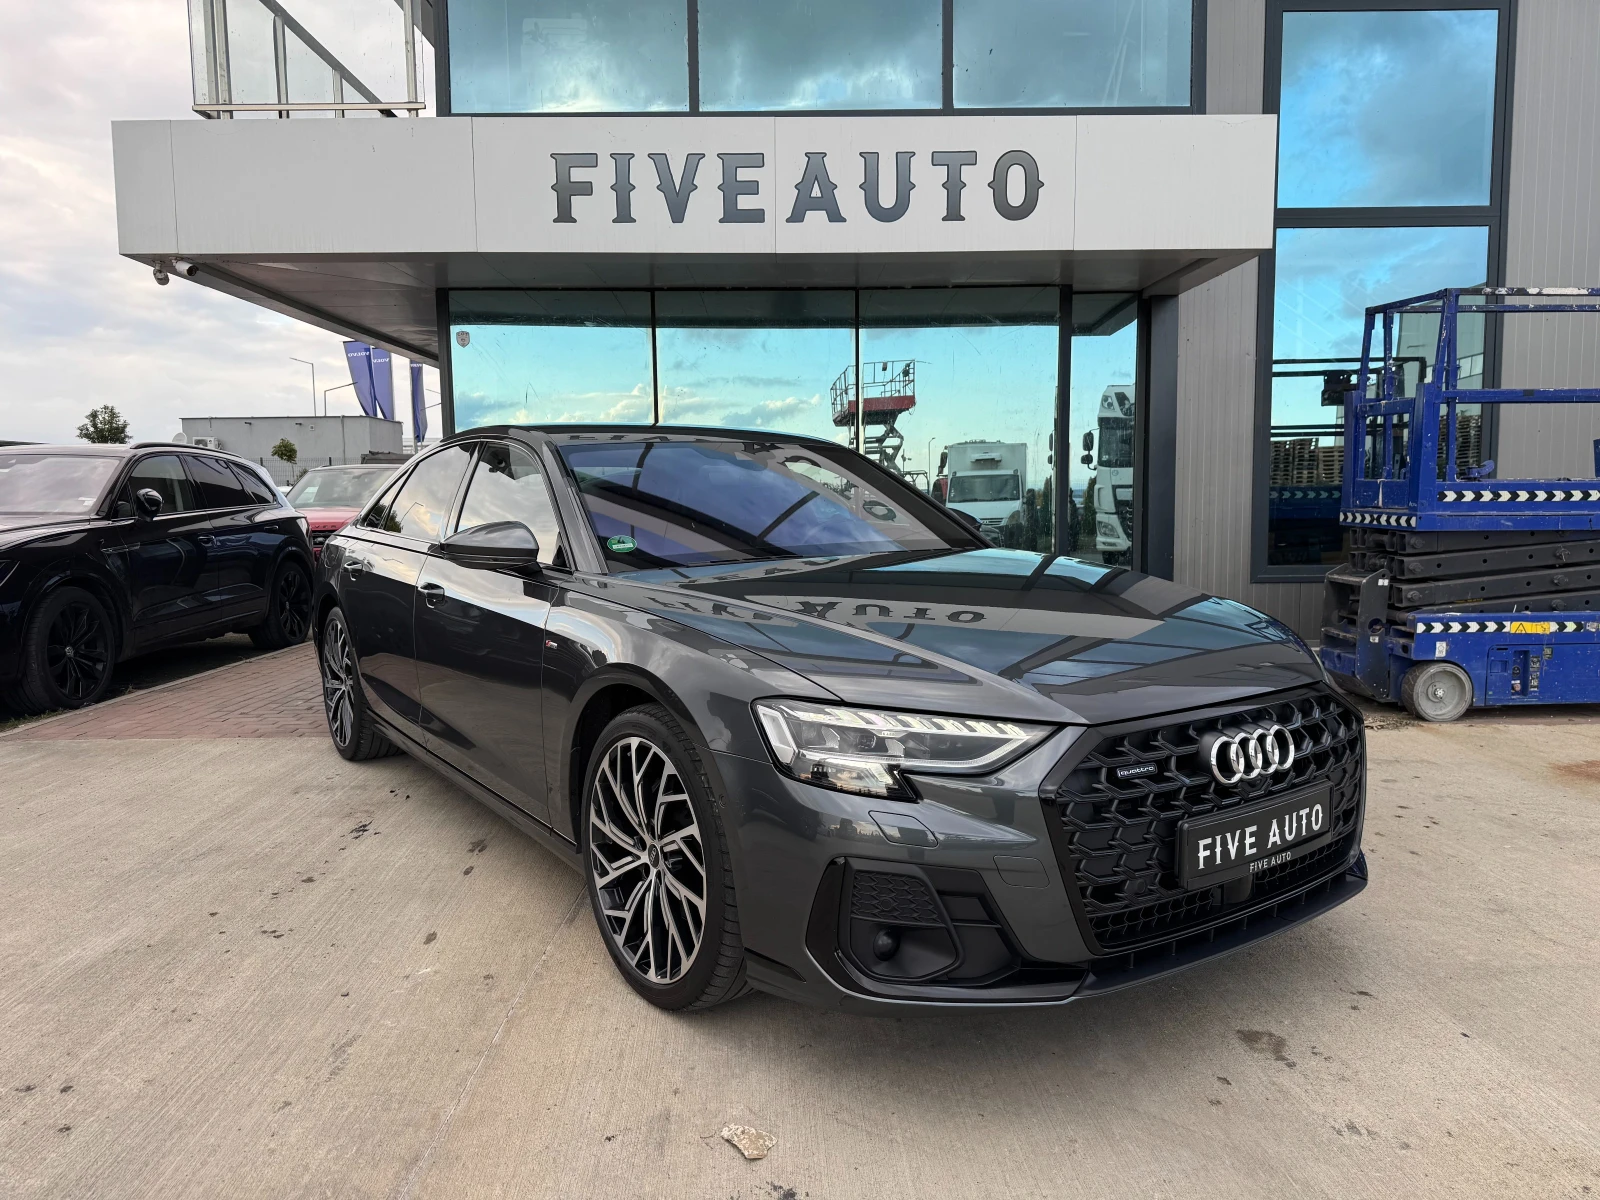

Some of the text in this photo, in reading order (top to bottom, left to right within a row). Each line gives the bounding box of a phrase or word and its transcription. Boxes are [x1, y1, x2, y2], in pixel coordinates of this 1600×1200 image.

[1119, 765, 1155, 777] quattro
[1197, 803, 1323, 870] FIVE AUTO
[1249, 851, 1292, 873] FIVE AUTO
